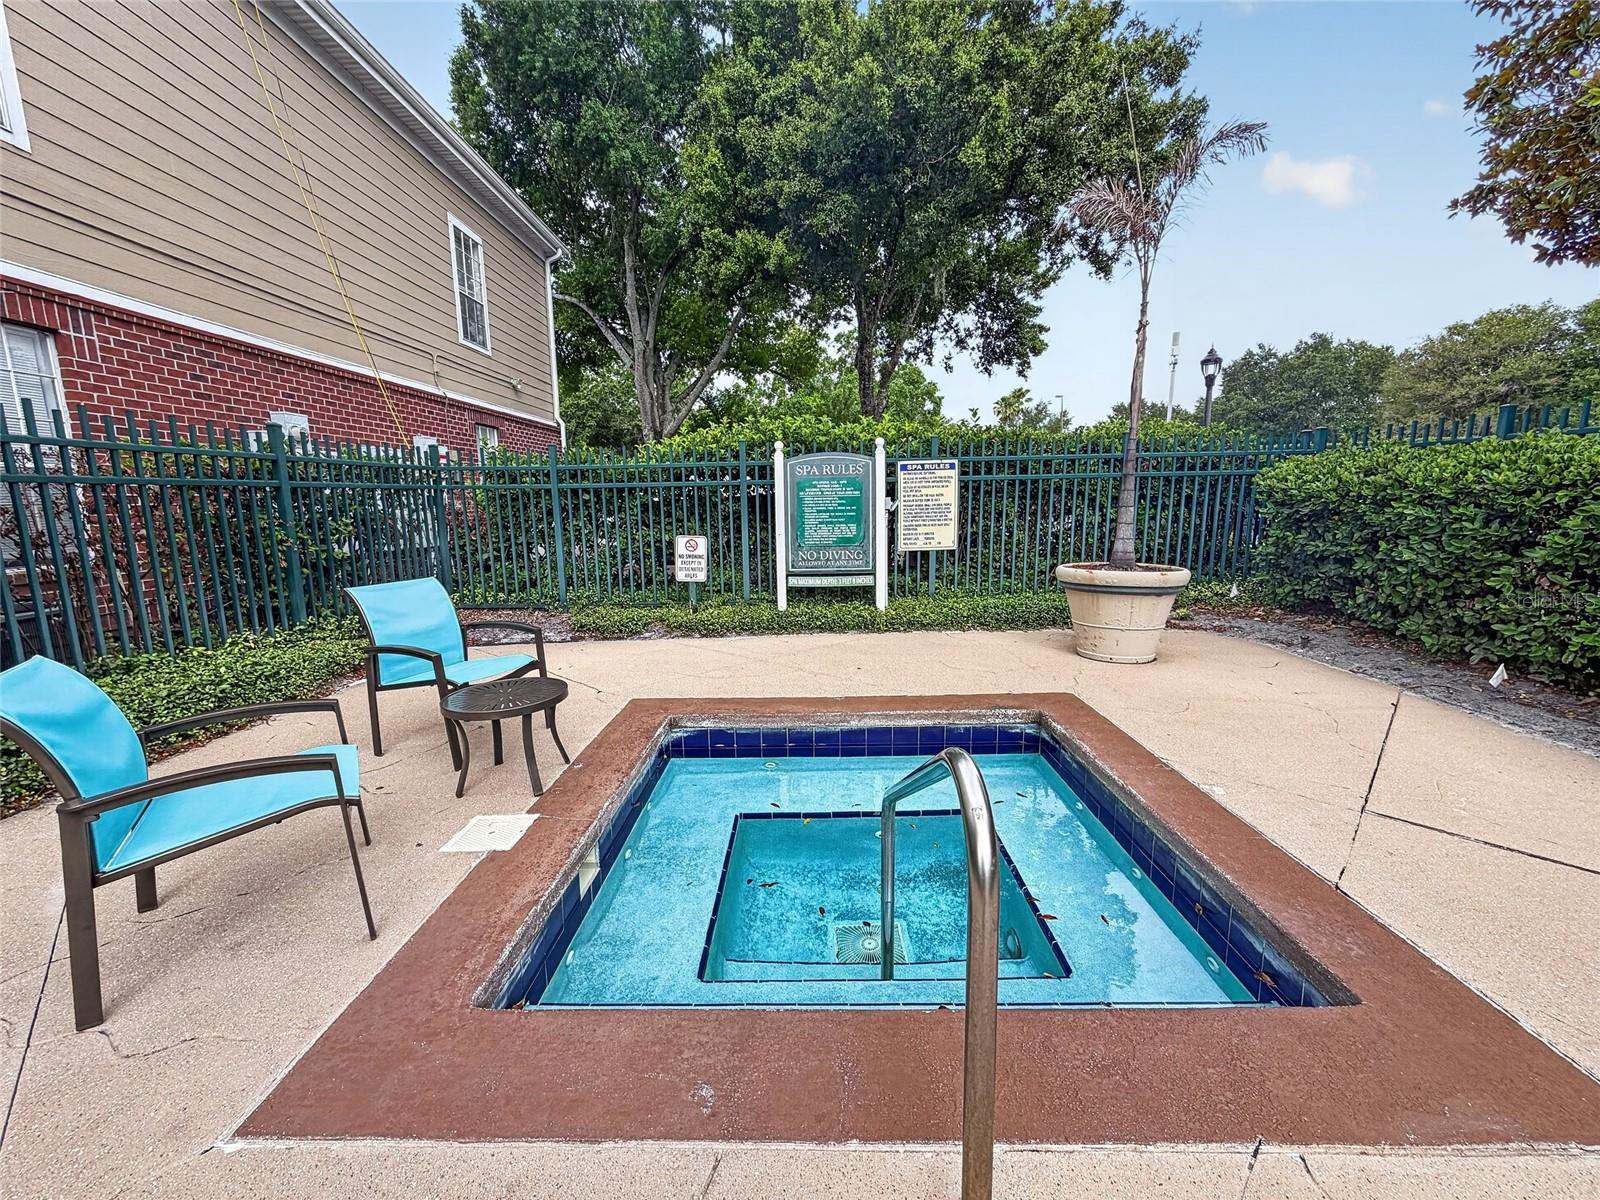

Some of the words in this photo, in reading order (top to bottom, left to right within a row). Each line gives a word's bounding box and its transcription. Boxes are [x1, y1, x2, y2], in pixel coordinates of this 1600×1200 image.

[795, 464, 820, 476] SPA
[822, 463, 864, 475] RULES
[798, 550, 816, 560] NO
[820, 550, 863, 560] DIVING
